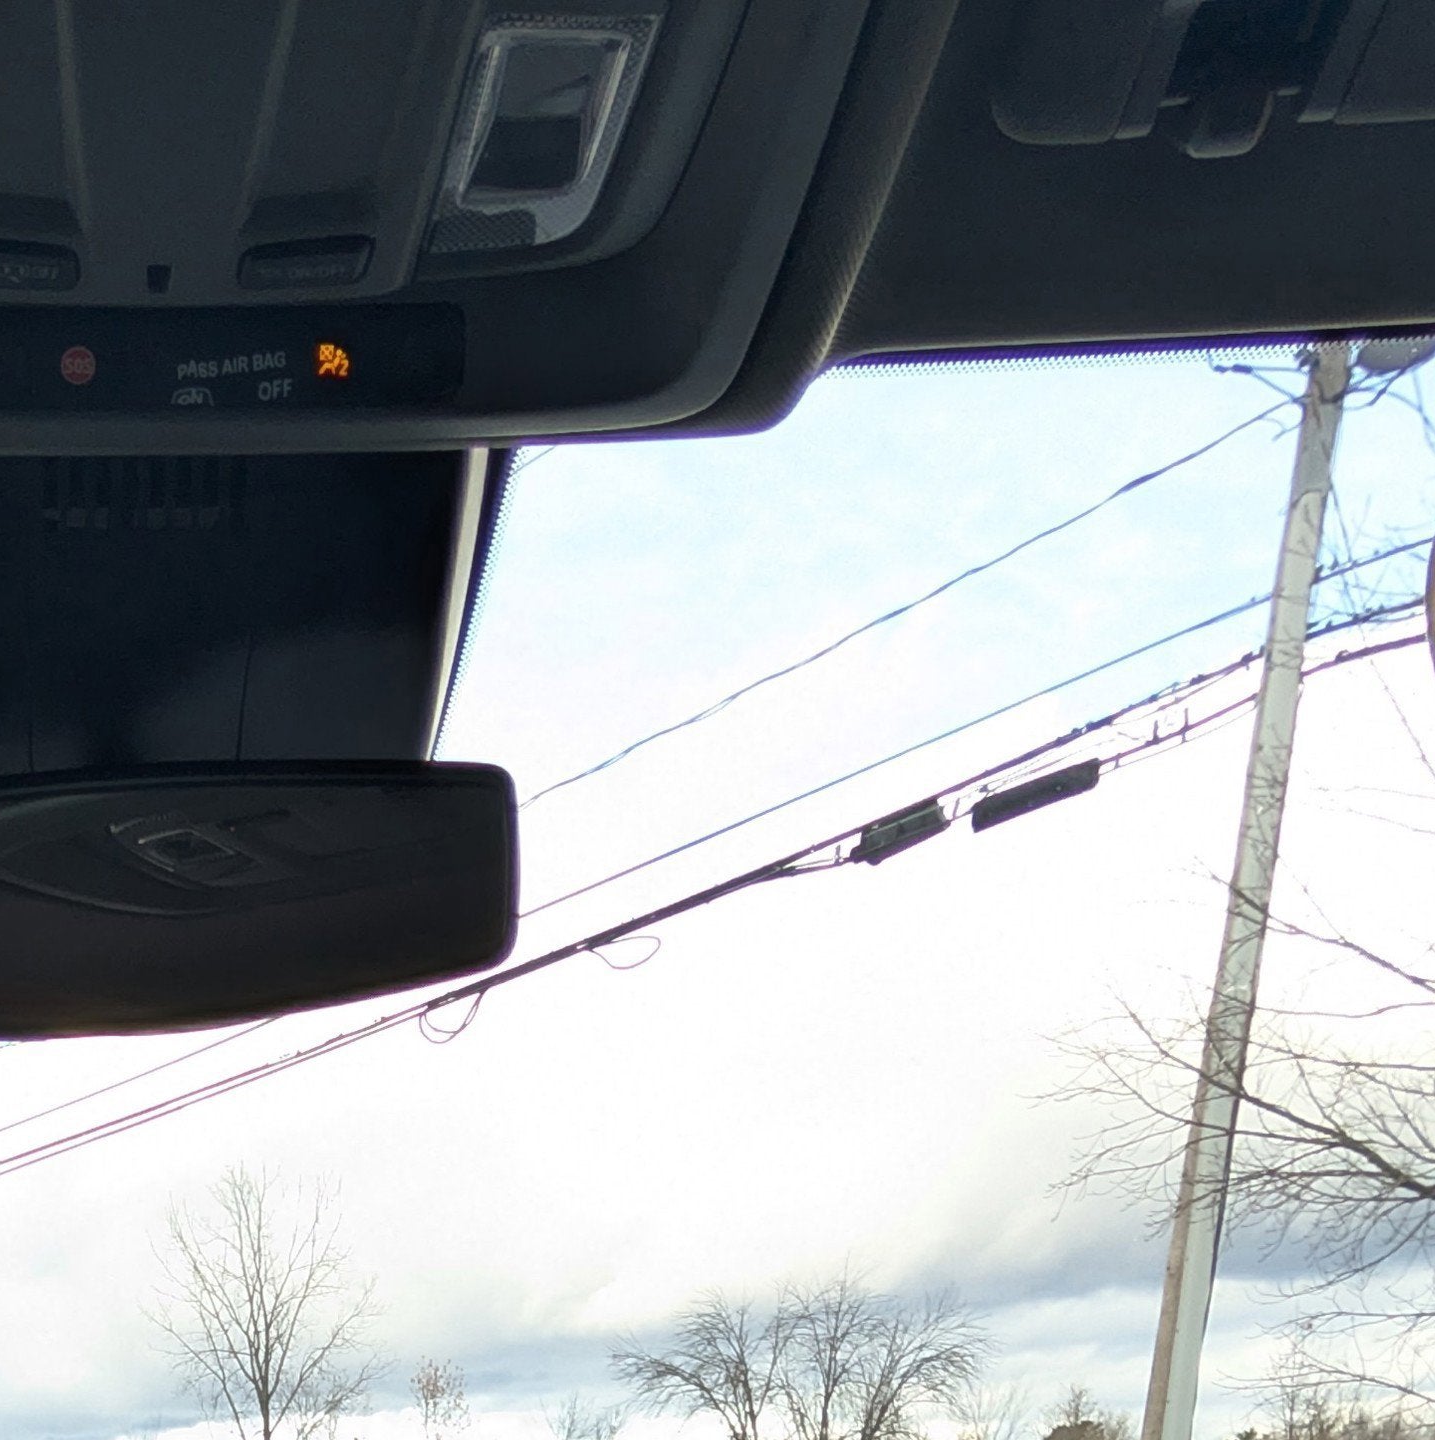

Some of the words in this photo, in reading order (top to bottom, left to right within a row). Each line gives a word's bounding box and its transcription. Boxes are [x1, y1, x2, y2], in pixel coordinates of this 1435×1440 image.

[66, 359, 92, 375] SOS
[177, 359, 218, 380] PASS
[221, 356, 250, 376] AIR
[253, 351, 286, 372] BAG
[258, 379, 293, 401] OFF
